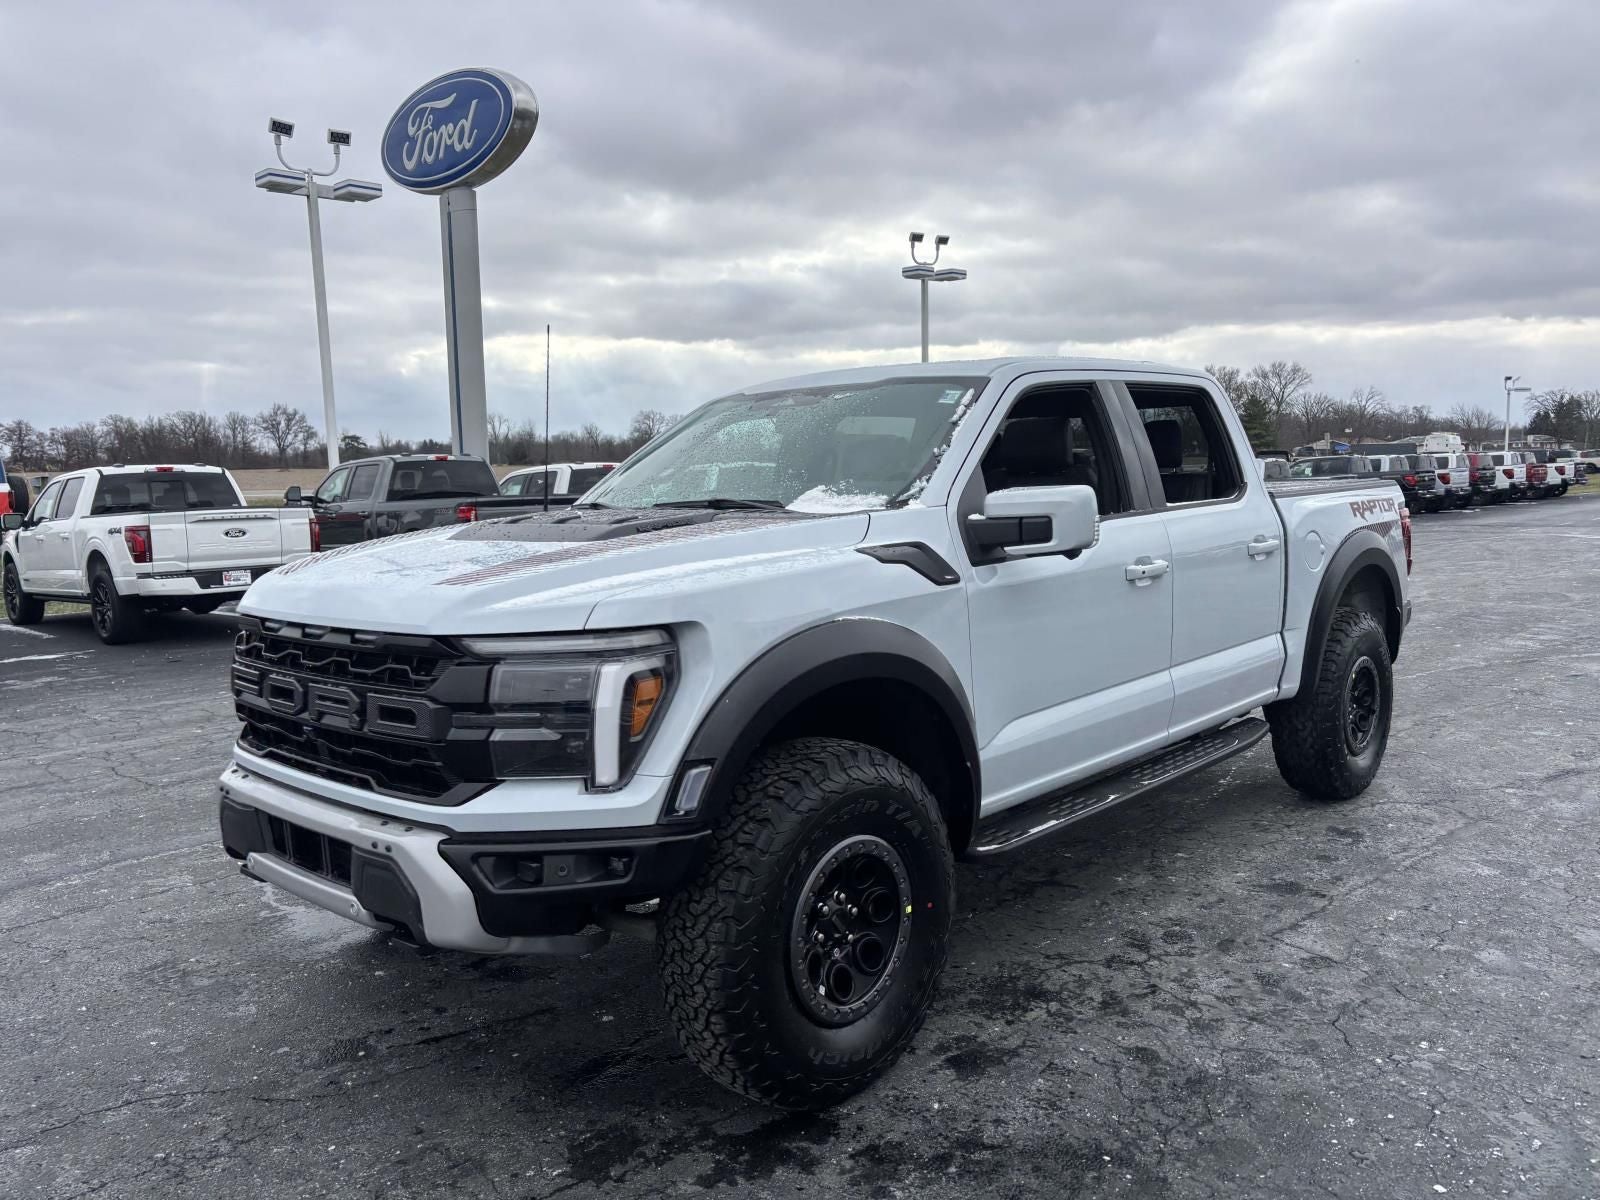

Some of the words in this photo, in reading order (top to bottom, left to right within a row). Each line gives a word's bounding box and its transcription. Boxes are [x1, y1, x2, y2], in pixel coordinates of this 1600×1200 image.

[402, 92, 479, 171] Ford
[1349, 498, 1398, 522] RAPTOR
[231, 663, 448, 743] FORD
